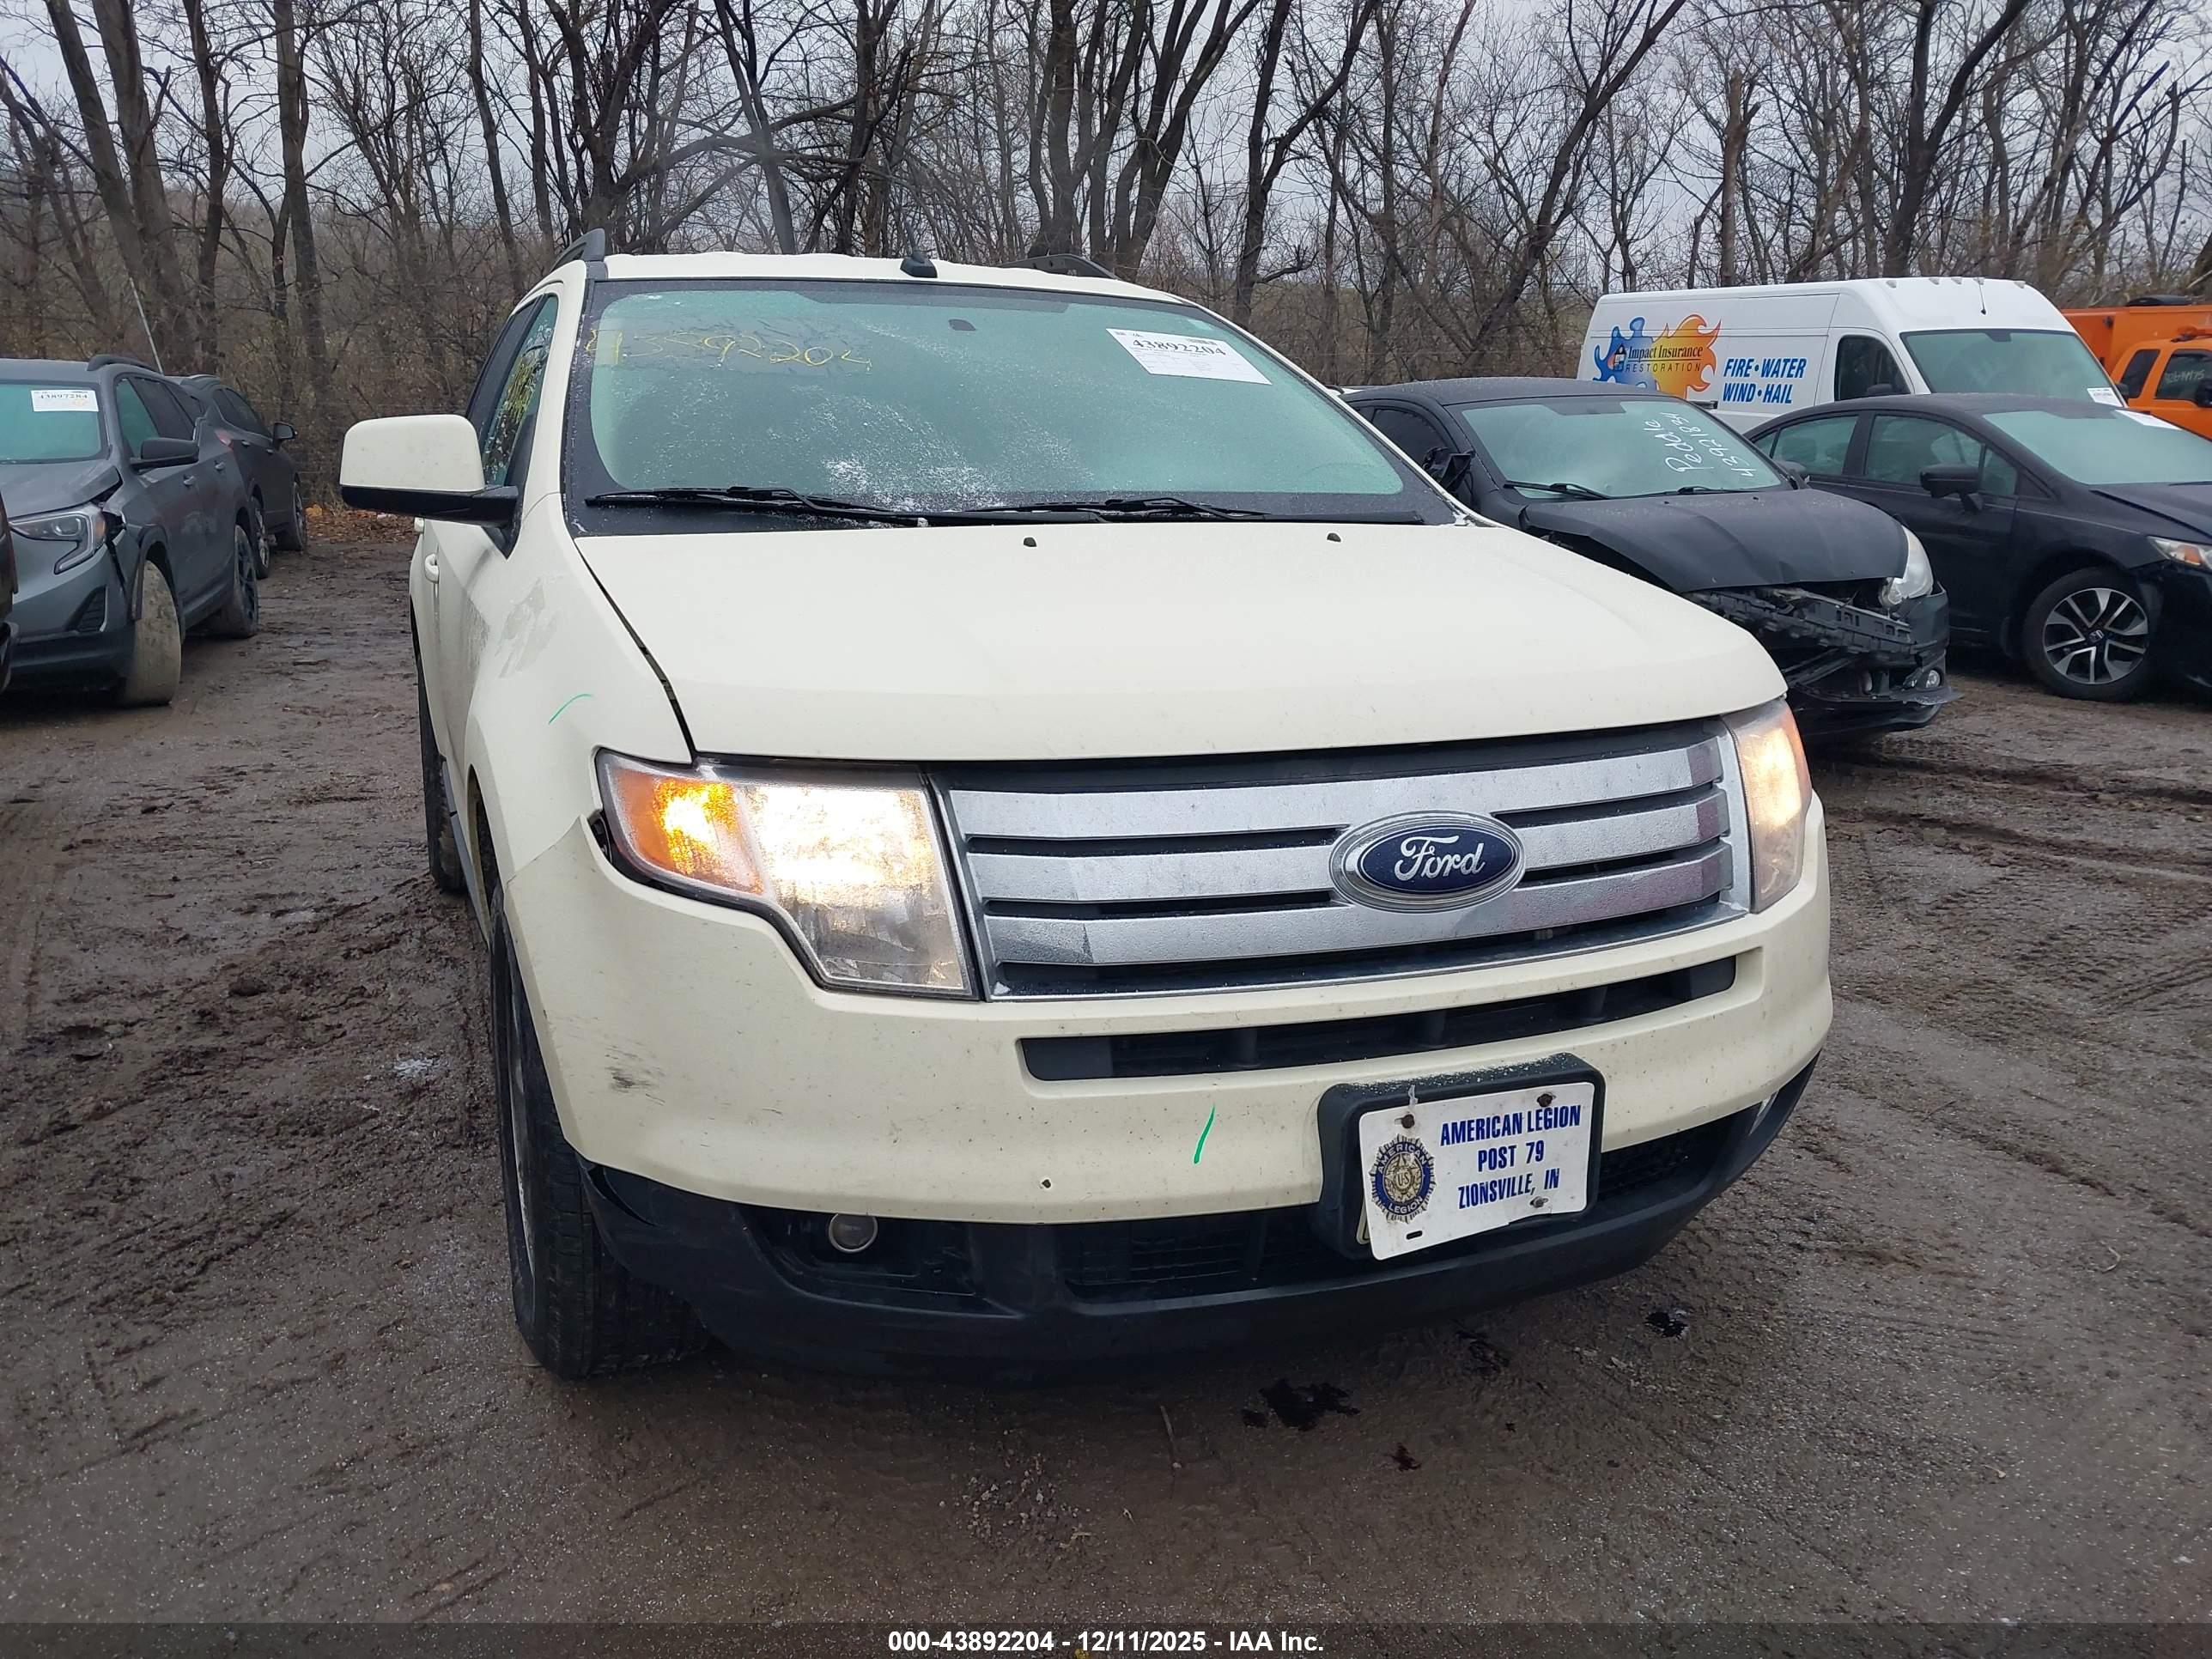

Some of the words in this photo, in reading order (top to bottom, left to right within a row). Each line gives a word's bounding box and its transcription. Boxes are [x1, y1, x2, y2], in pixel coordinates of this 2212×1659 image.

[1133, 339, 1226, 356] 43892204
[1628, 345, 1658, 360] Impact
[1658, 344, 1704, 358] Insurance
[1626, 362, 1701, 373] RESTORATION
[1644, 419, 1714, 472] Peddle
[1661, 412, 1757, 477] 43921834
[1394, 835, 1486, 882] Ford
[1440, 1112, 1523, 1146] AMERICAN
[1527, 1104, 1582, 1133] LEGION
[1377, 1143, 1427, 1174] AMERICAN
[1478, 1145, 1517, 1172] POST
[1526, 1139, 1545, 1164] 79
[1388, 1195, 1424, 1214] LEGION
[1457, 1173, 1536, 1210] ZIONSVILLE,
[1543, 1168, 1560, 1190] IN
